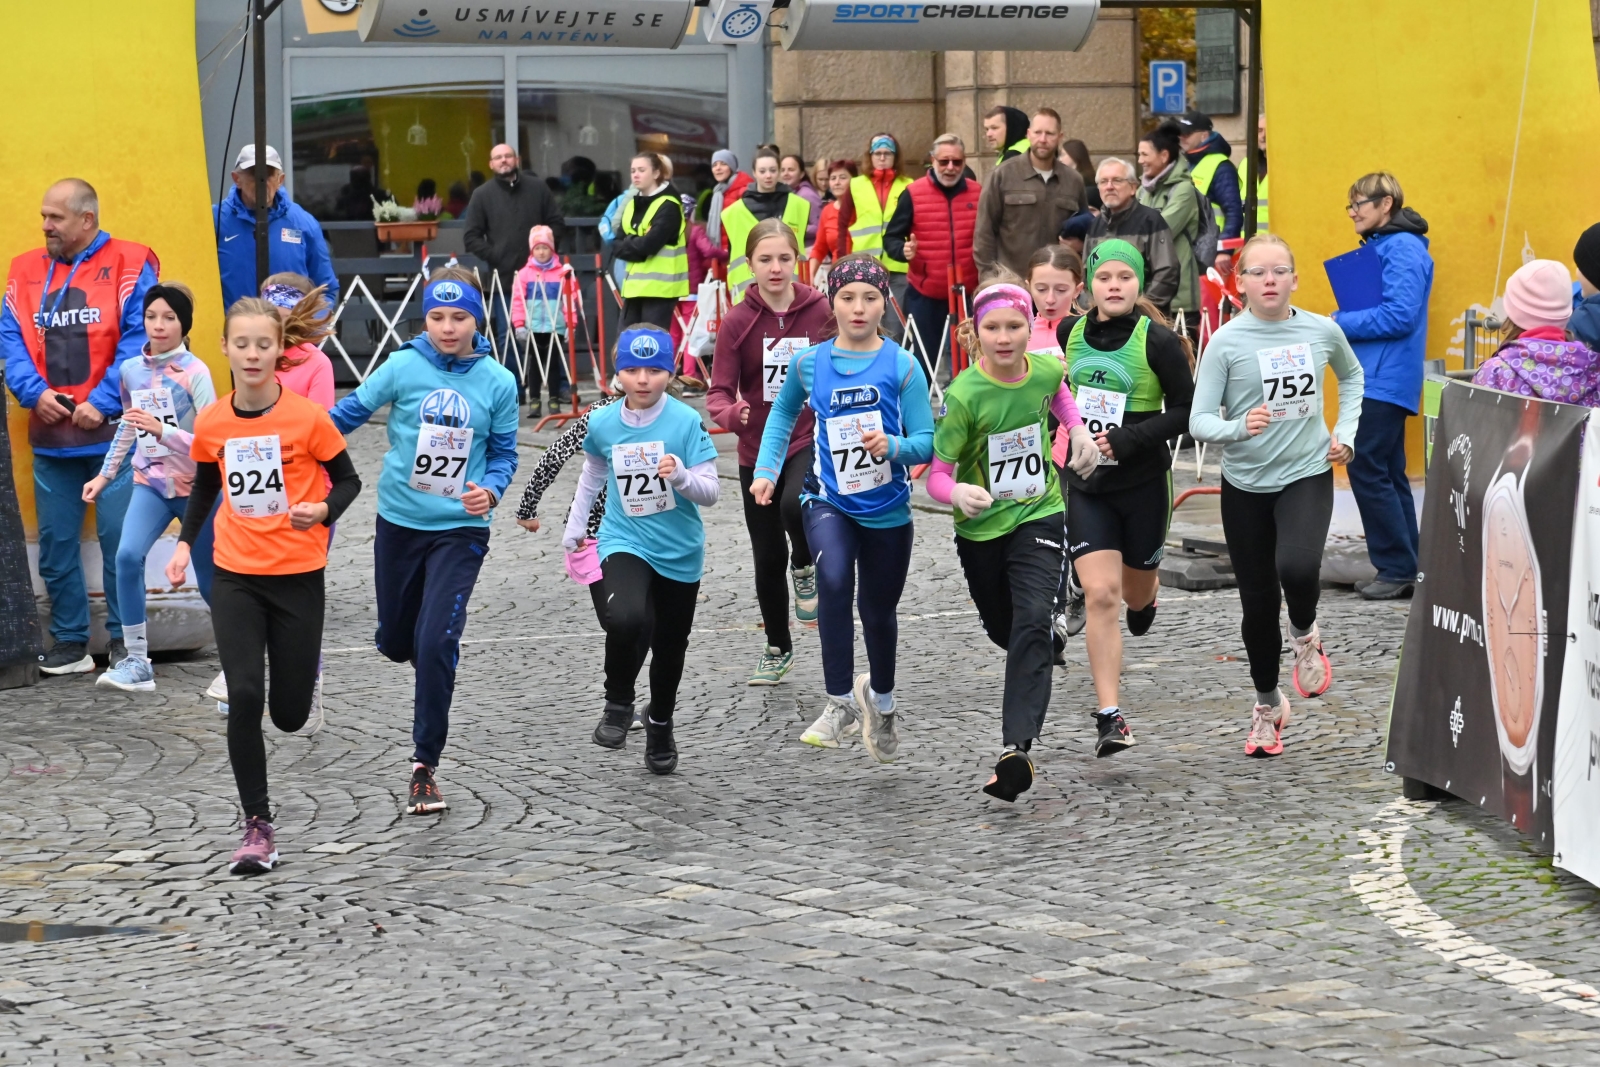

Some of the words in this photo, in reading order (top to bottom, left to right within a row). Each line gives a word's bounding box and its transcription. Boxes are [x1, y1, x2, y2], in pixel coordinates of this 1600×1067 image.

[454, 5, 617, 28] USMÍVEJTE
[632, 13, 664, 28] SE
[478, 29, 508, 40] NA
[520, 28, 620, 43] ANTÉNY.
[1157, 67, 1179, 98] P
[1263, 373, 1315, 401] 752
[415, 454, 468, 478] 927
[990, 453, 1041, 484] 770
[228, 468, 284, 497] 924
[616, 473, 667, 496] 721
